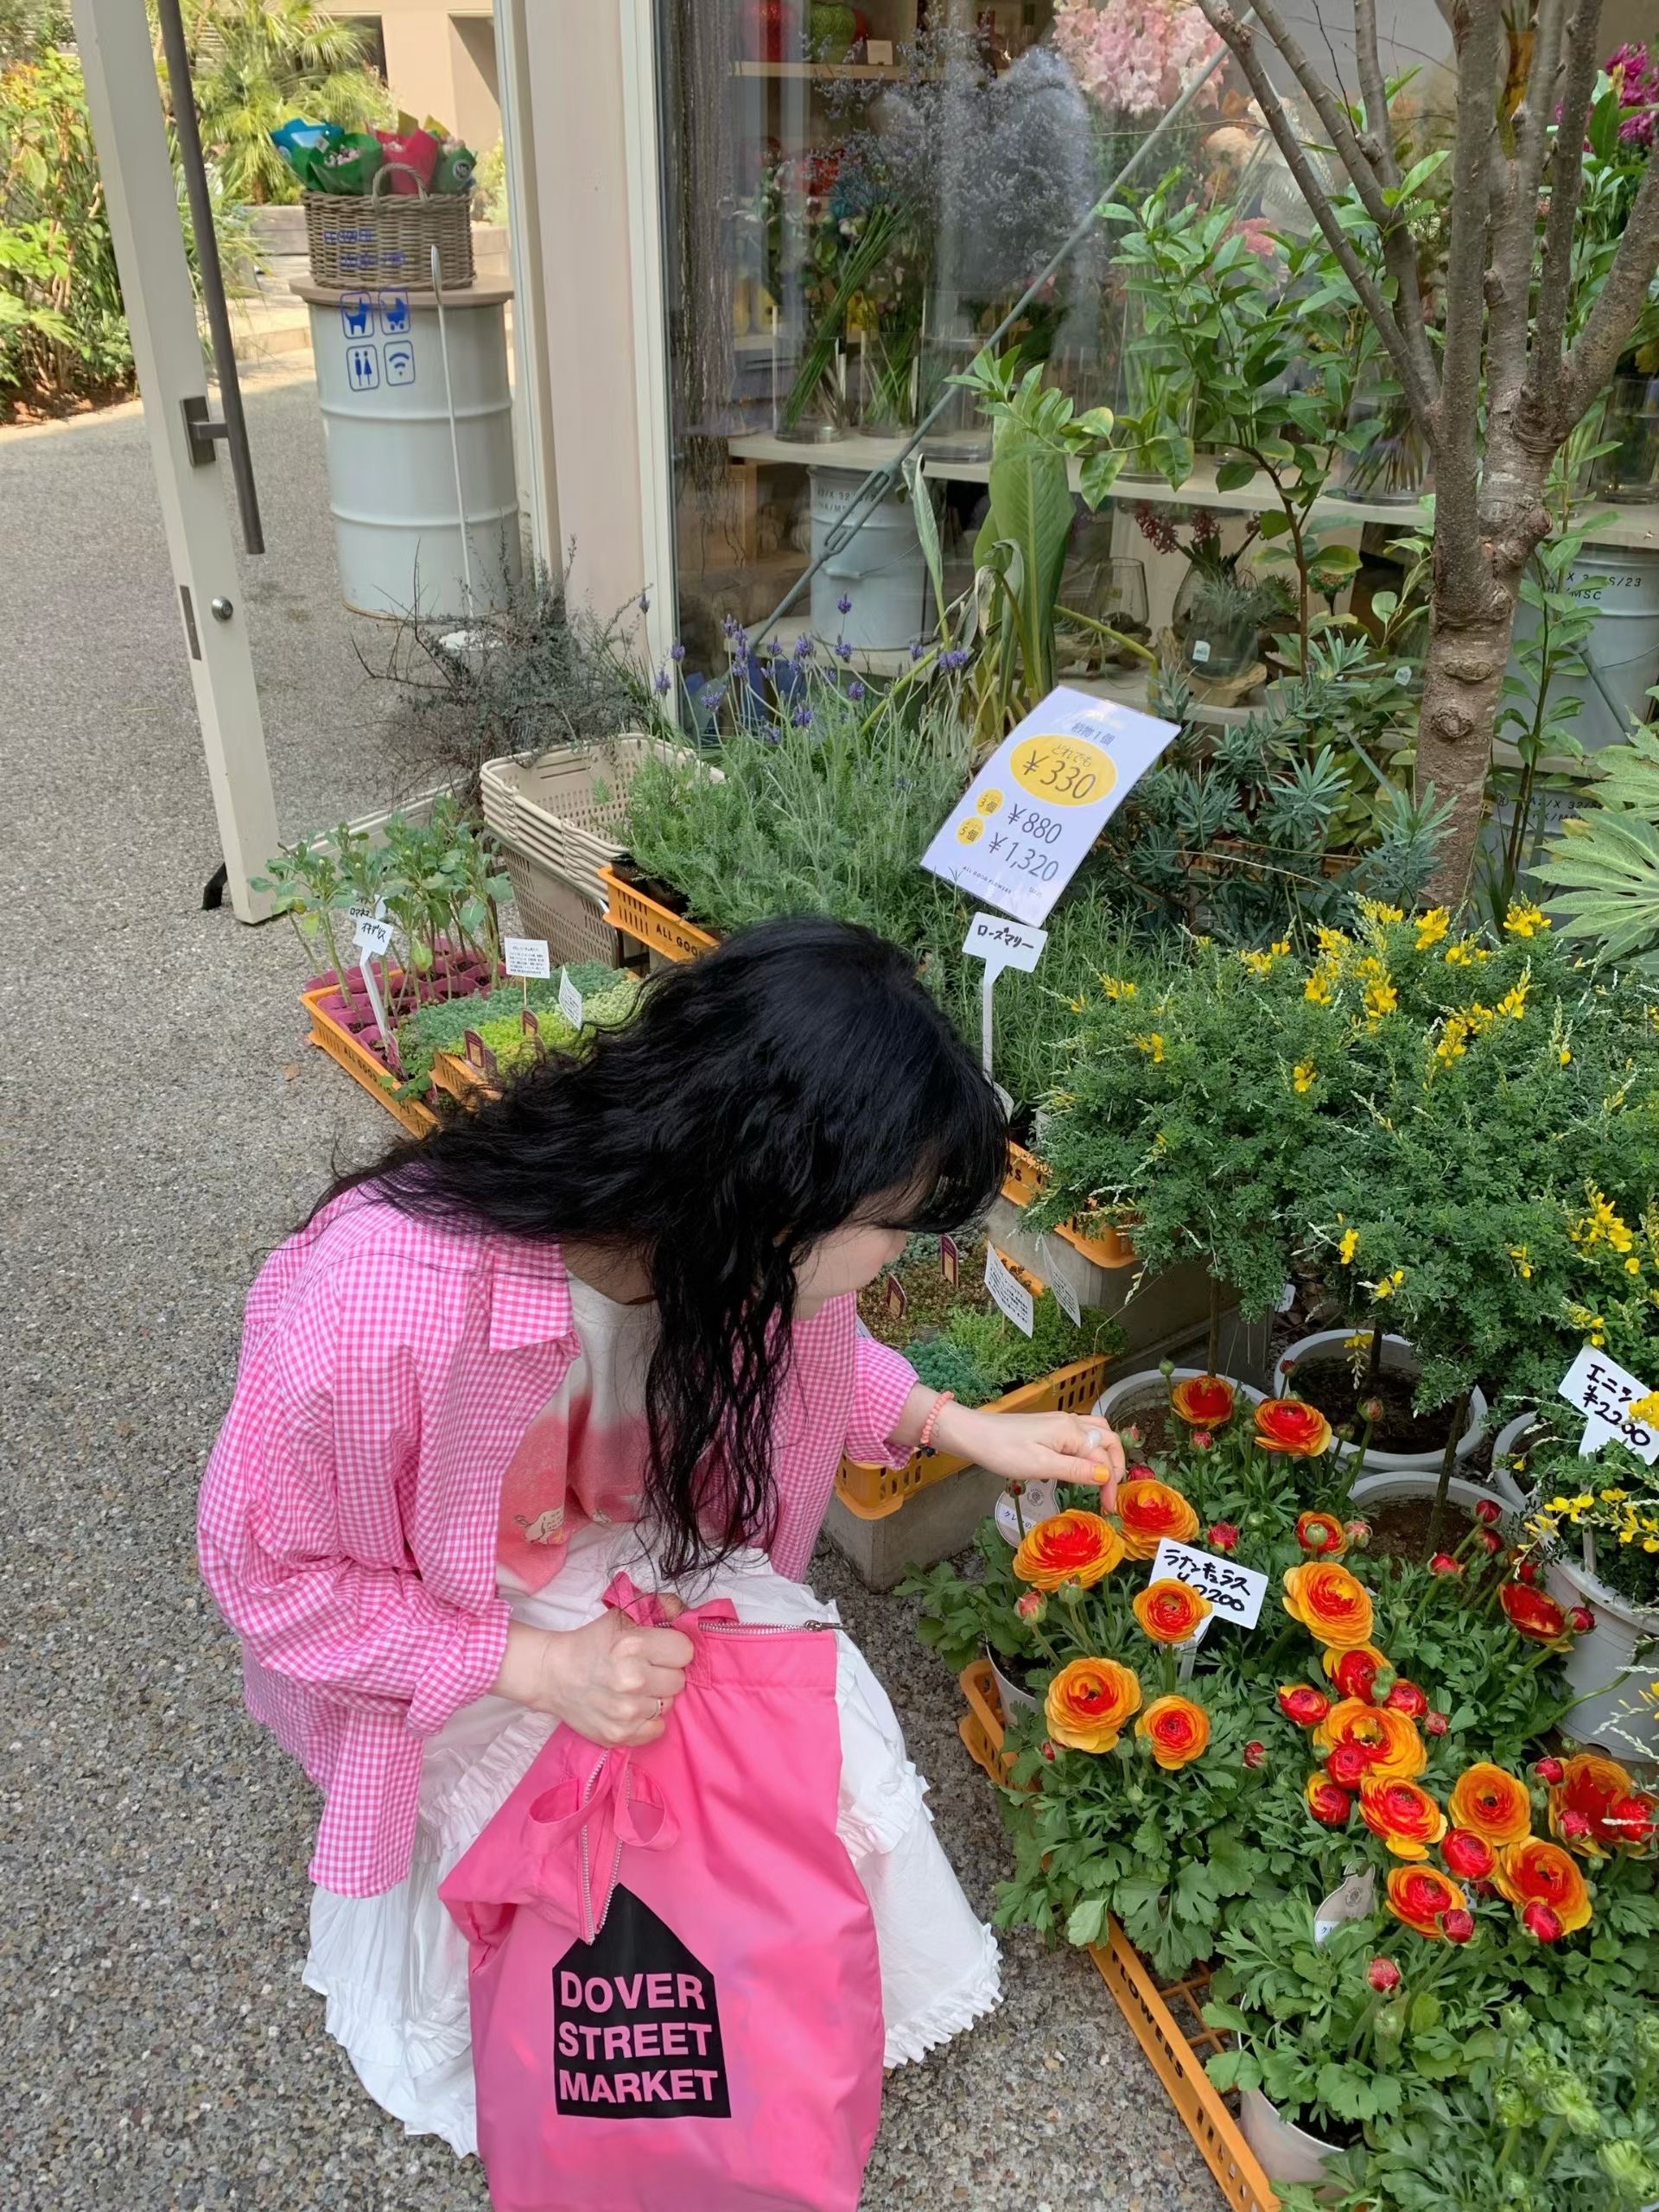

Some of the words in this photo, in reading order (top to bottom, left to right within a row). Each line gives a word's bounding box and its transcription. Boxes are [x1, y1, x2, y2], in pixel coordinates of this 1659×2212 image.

[1023, 749, 1096, 799] ¥330
[1052, 743, 1093, 767] どれでも
[1007, 803, 1062, 844] ¥880
[988, 831, 1059, 882] ¥1,320
[657, 923, 672, 942] ALL
[677, 936, 698, 957] GOO
[977, 924, 1034, 949] ローズマリー
[1582, 1384, 1651, 1446] ¥2200
[1163, 1548, 1251, 1597] ラナンキュラス
[560, 1970, 706, 2013] DOVER
[1111, 1948, 1184, 2079] FLOWERS
[558, 2021, 713, 2061] STREET
[559, 2069, 719, 2104] MARKET
